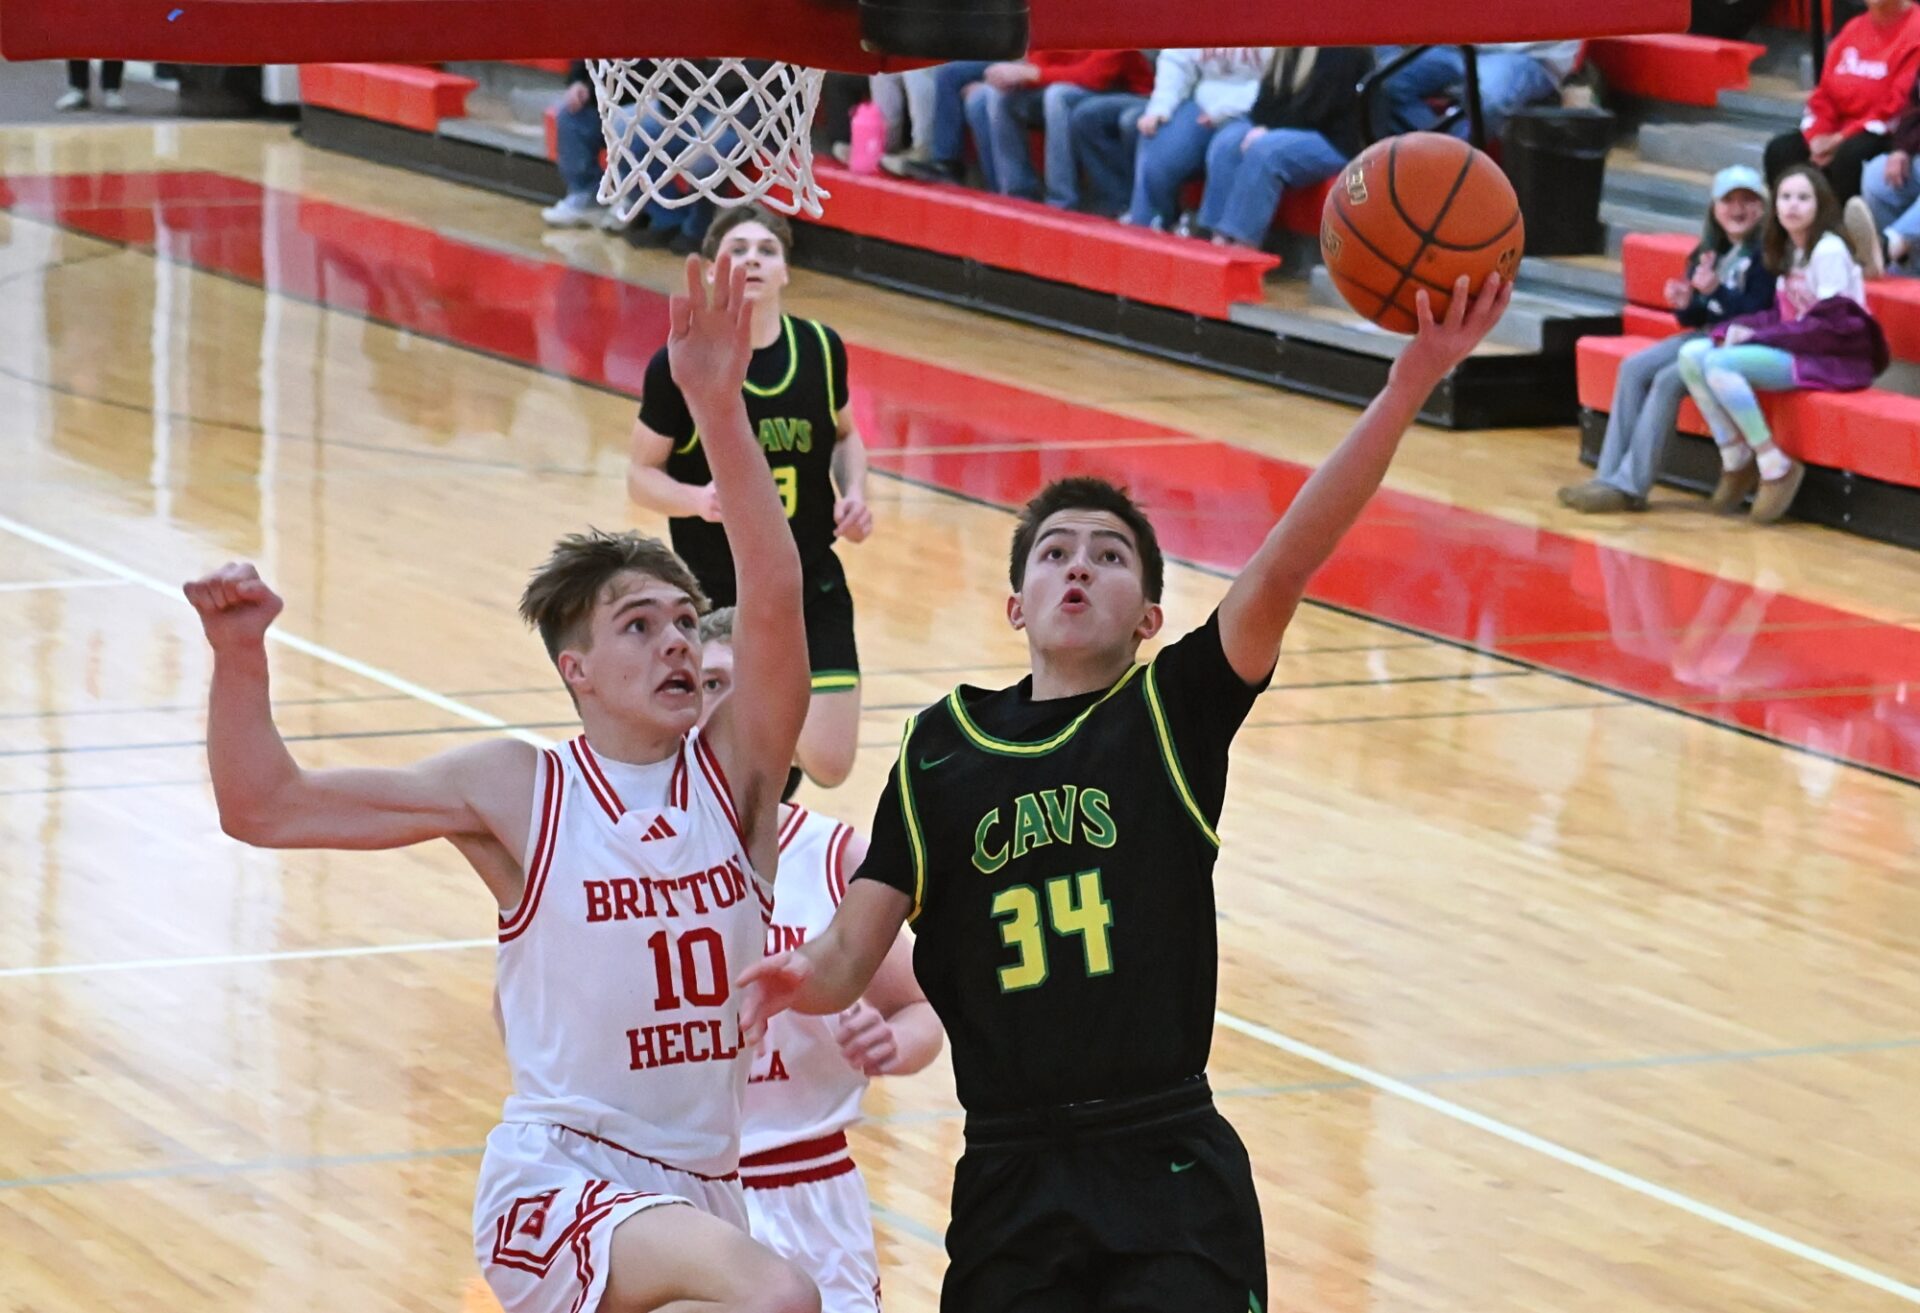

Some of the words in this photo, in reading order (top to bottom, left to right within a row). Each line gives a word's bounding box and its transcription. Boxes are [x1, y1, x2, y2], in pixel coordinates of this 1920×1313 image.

[758, 417, 812, 453] AVS
[971, 784, 1117, 874] CAVS
[583, 854, 747, 923] BRITTON
[648, 927, 729, 1011] 10
[990, 868, 1114, 994] 34
